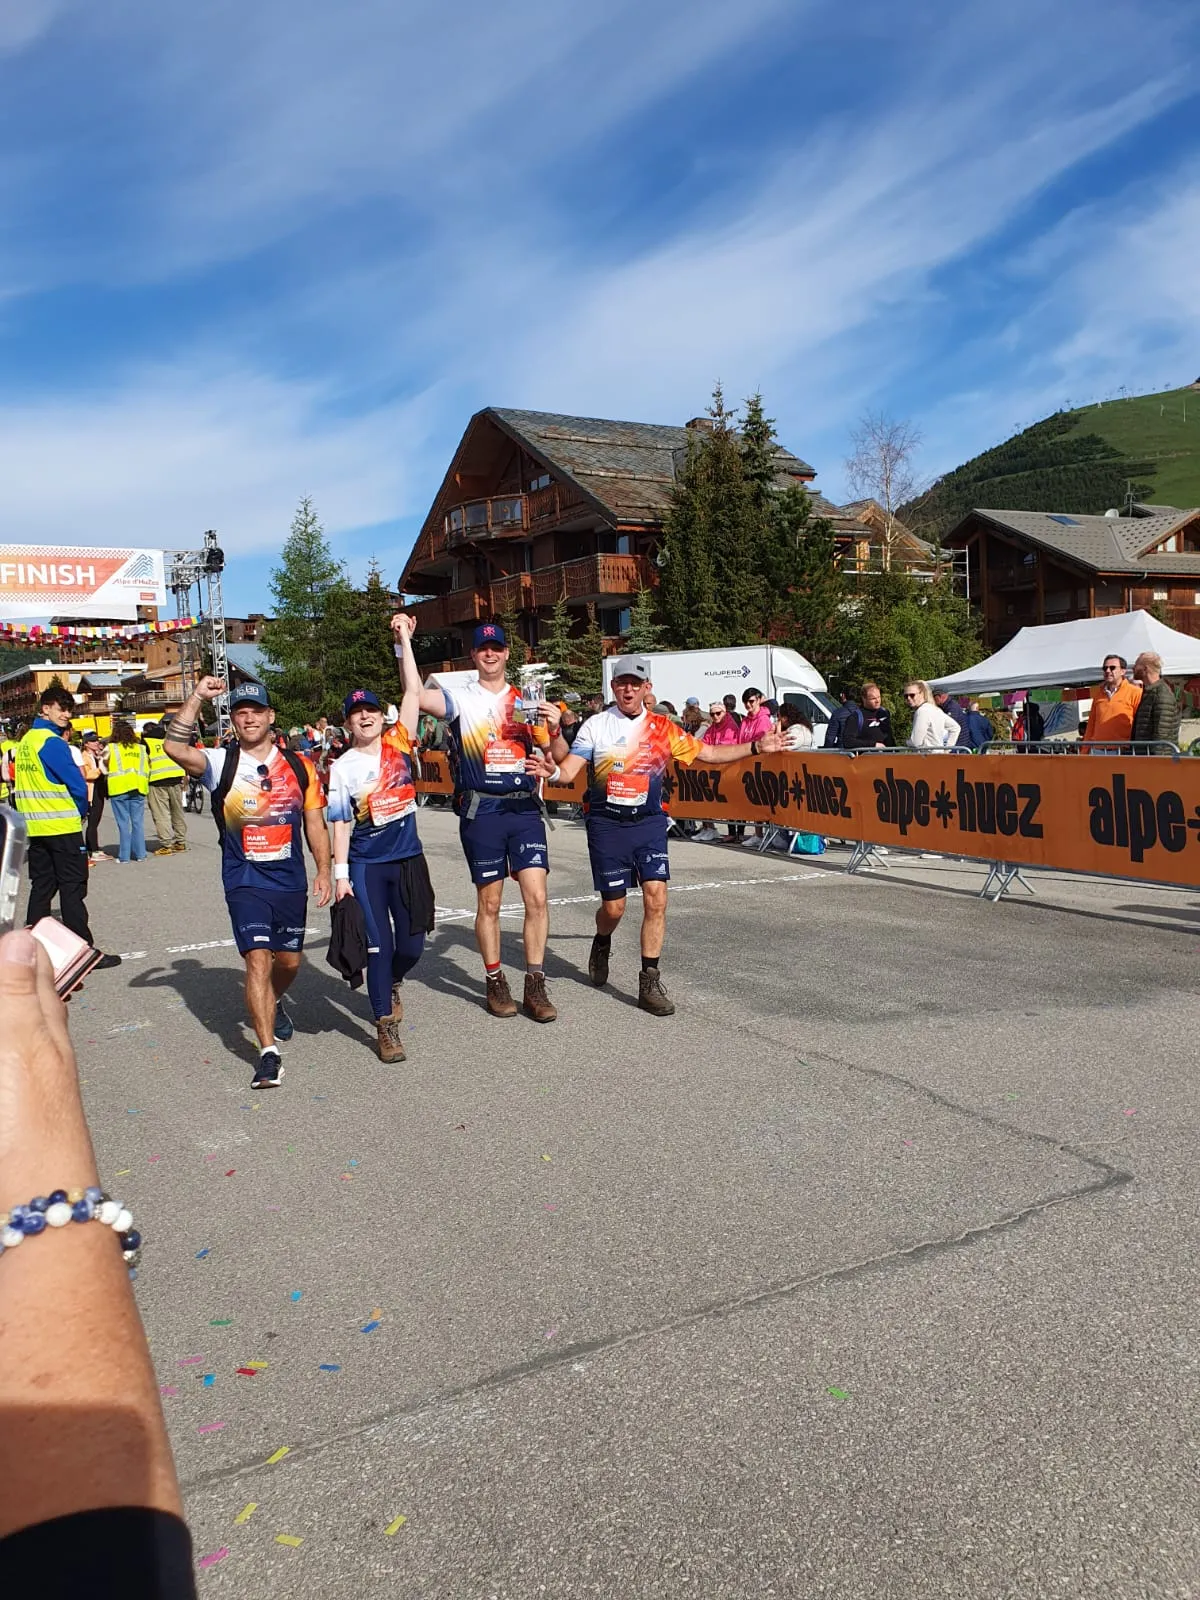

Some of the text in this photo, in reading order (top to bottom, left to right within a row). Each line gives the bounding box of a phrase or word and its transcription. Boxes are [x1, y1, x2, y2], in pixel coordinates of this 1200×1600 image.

[0, 563, 96, 586] FINISH
[704, 669, 742, 677] KUIJPERS
[673, 760, 728, 803] huez
[742, 761, 853, 819] alpe huez
[873, 768, 1044, 840] alpe huez
[1088, 773, 1188, 863] alpe
